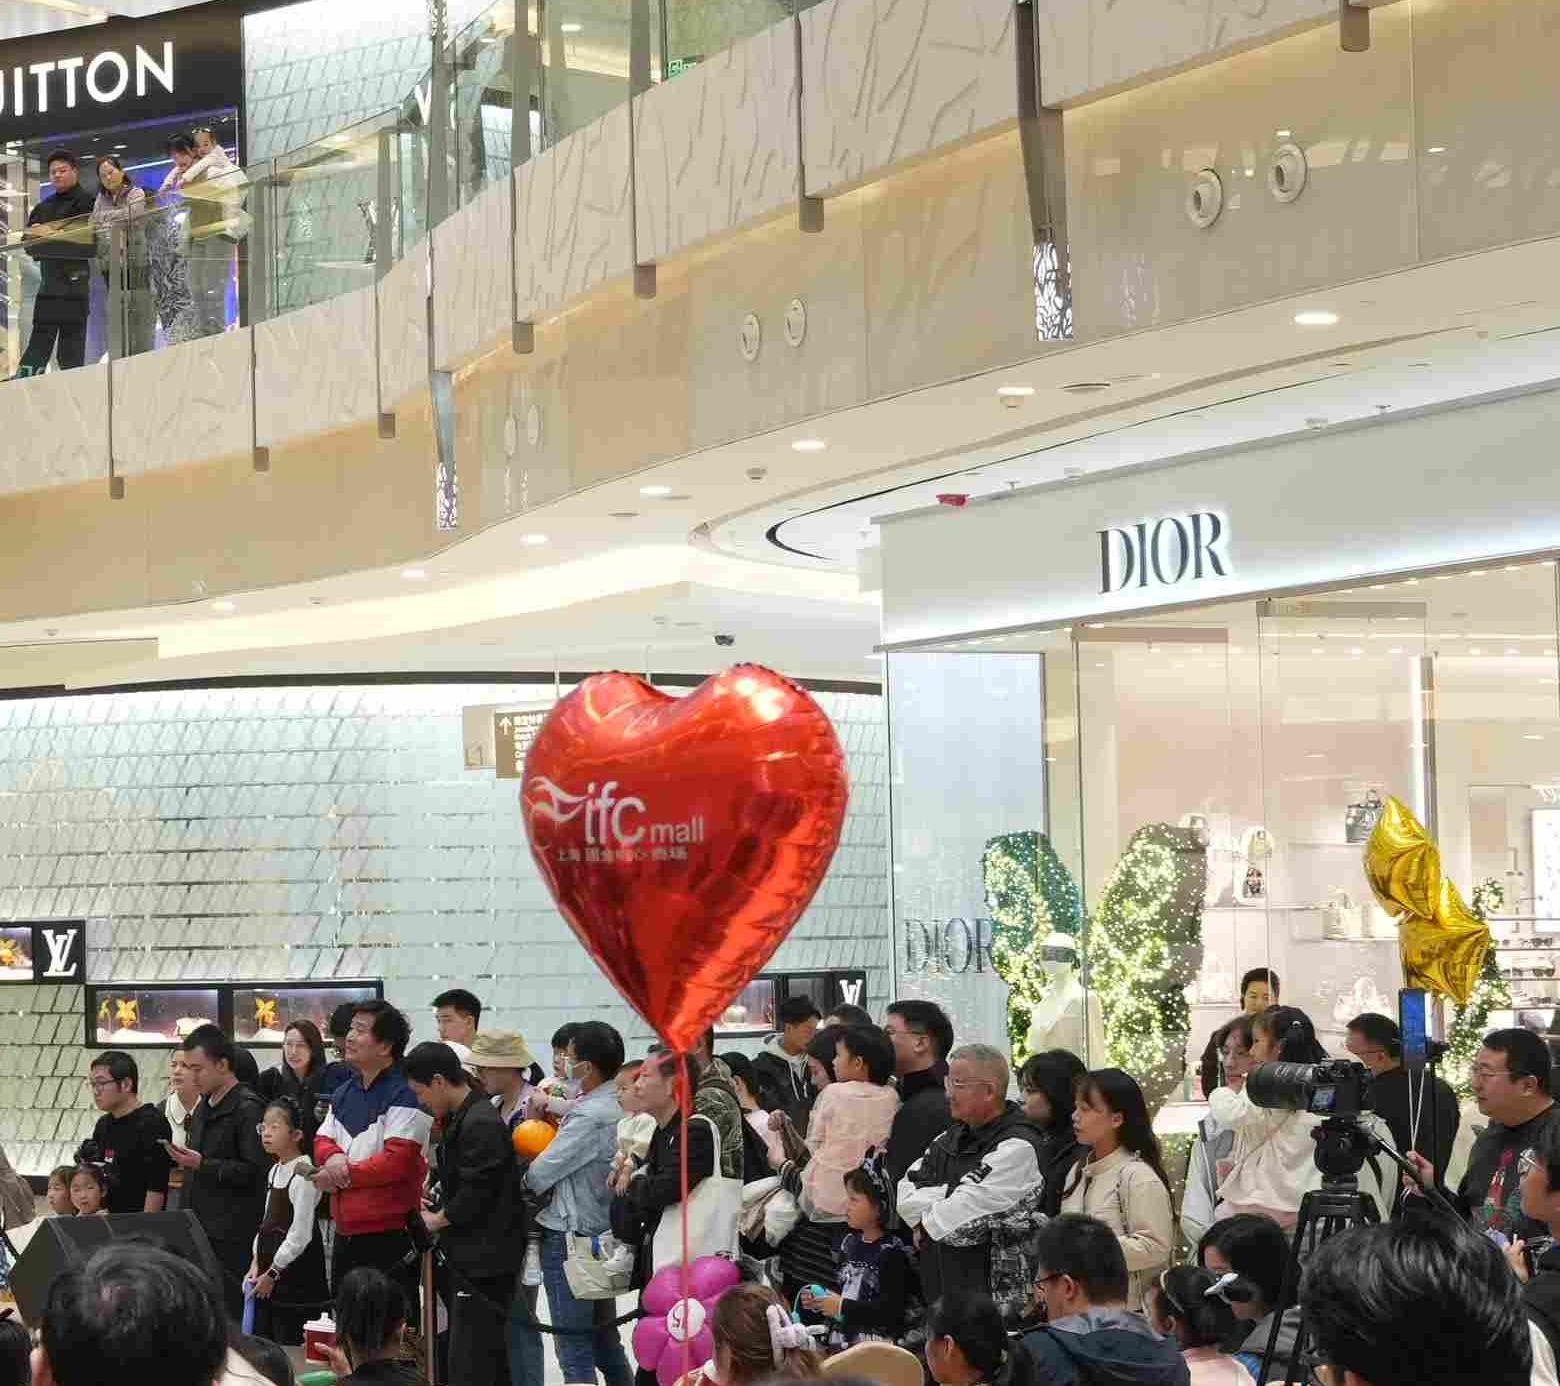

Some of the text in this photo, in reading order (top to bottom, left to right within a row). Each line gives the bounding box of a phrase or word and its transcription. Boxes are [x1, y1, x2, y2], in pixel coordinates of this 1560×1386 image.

[1096, 512, 1226, 594] DIOR
[584, 781, 705, 844] ifc mall
